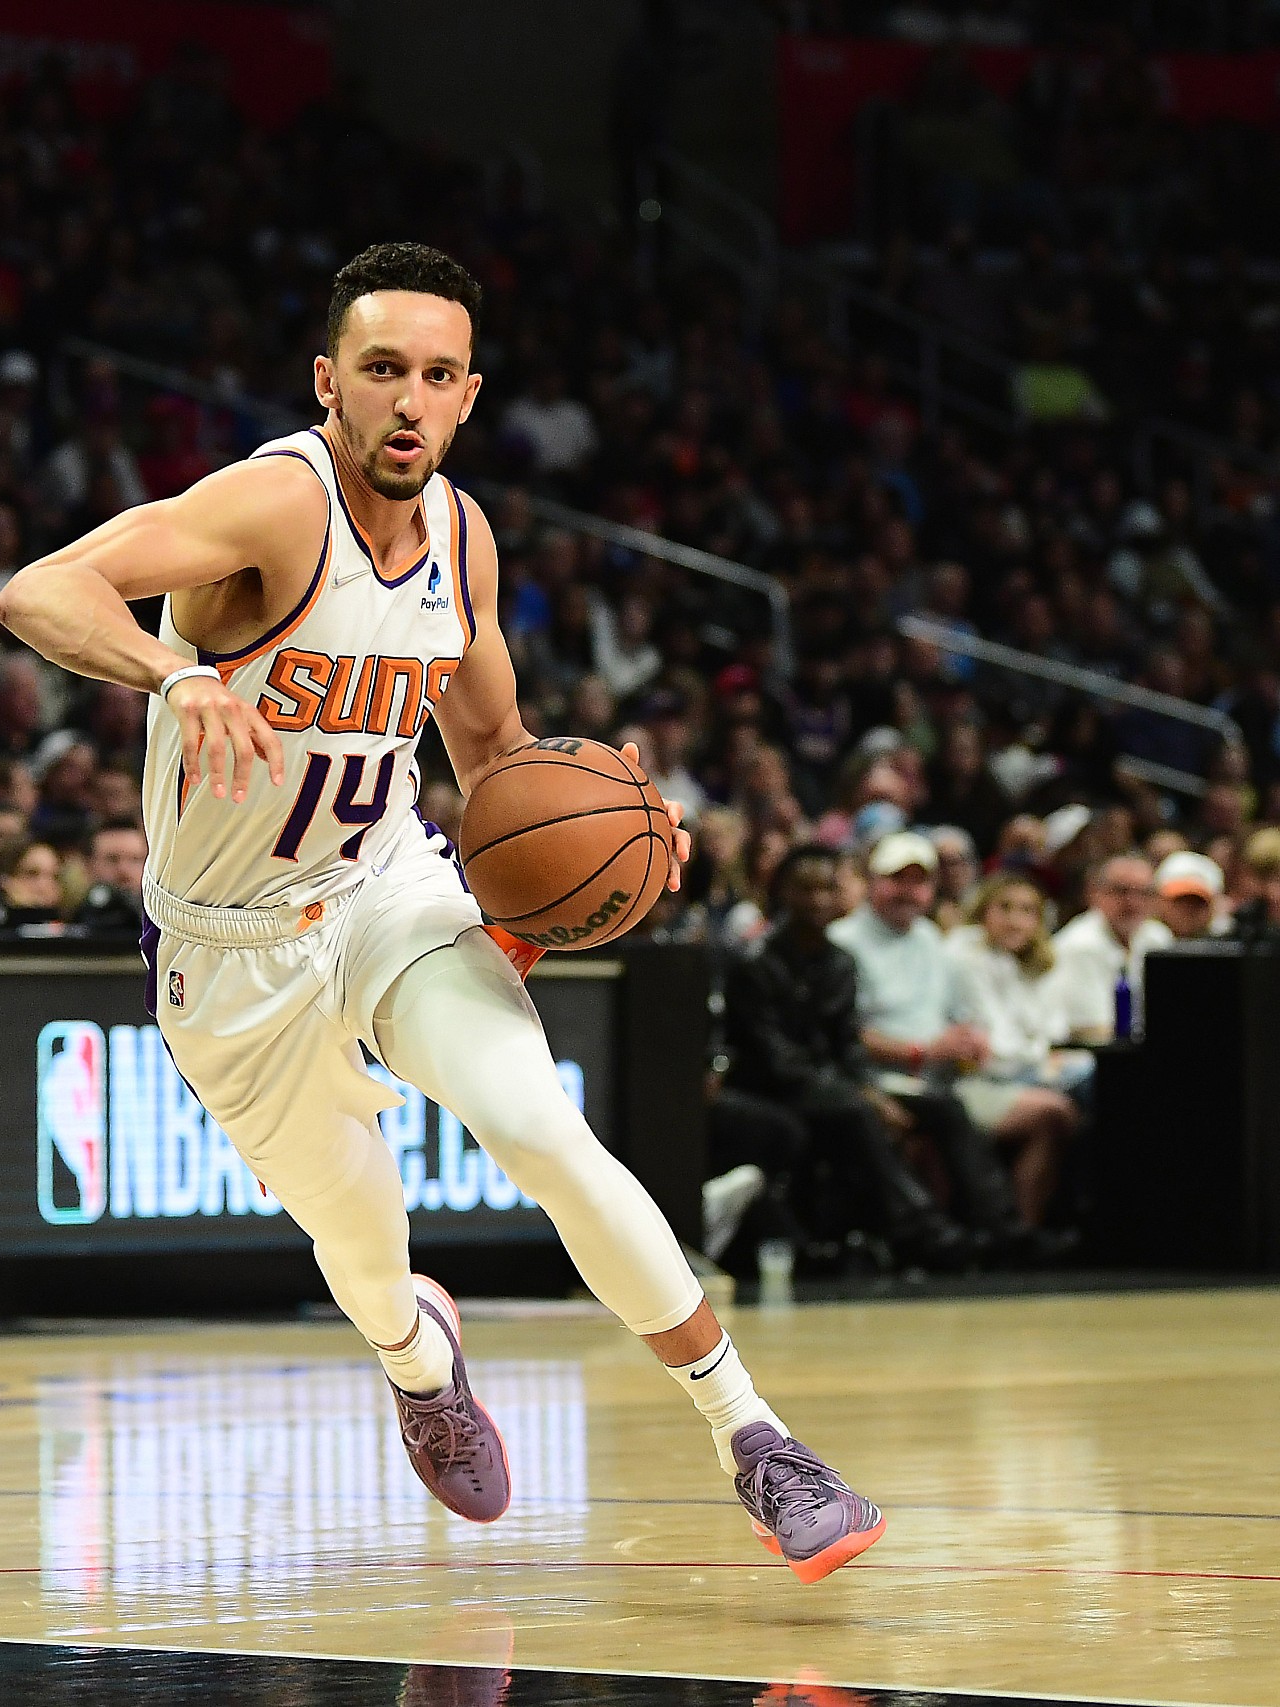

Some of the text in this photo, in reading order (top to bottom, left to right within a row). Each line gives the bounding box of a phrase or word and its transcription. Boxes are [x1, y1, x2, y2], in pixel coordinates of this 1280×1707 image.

[421, 597, 449, 611] PayPal
[256, 647, 460, 739] SUNS
[270, 750, 396, 863] 14
